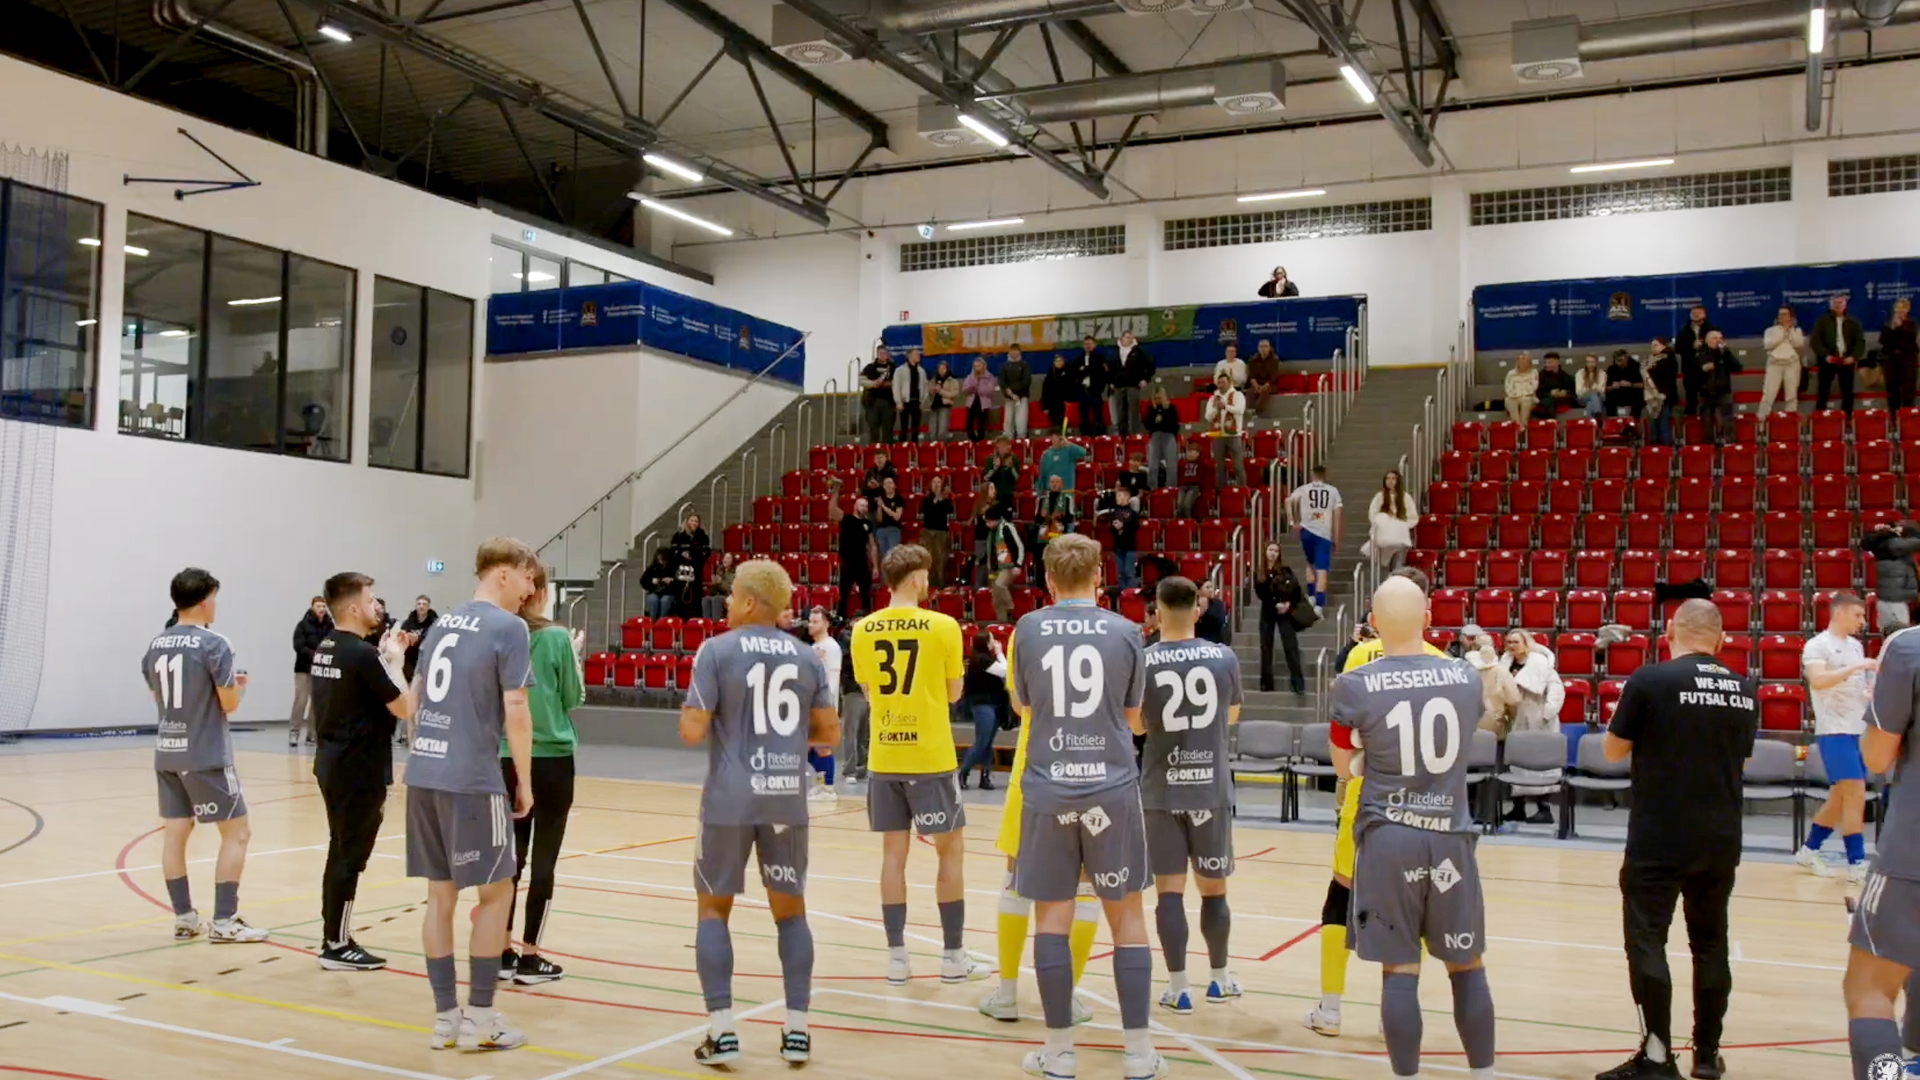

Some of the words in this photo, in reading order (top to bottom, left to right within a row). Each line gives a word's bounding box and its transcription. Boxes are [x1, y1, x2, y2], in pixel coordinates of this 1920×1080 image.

[961, 323, 1033, 348] DUMA
[1042, 314, 1150, 344] KASZUB
[1309, 489, 1330, 509] 90
[437, 613, 481, 633] ROLL
[864, 619, 931, 633] OSTRAK
[1041, 619, 1108, 637] STOLC
[151, 635, 201, 650] FREITAS
[740, 636, 798, 656] MERA
[1145, 646, 1223, 667] ANKOWSKI
[426, 632, 460, 703] 6
[874, 639, 919, 695] 37
[154, 653, 183, 709] 11
[1041, 644, 1105, 718] 19
[1364, 666, 1469, 693] WESSERLING
[1694, 676, 1741, 692] WE-MET
[746, 662, 800, 737] 16
[1154, 665, 1218, 732] 29
[1680, 691, 1728, 706] FUTSAL
[1729, 694, 1754, 711] CLUB
[415, 737, 448, 754] OKTAN
[888, 731, 918, 742] OKTAN
[1066, 733, 1106, 746] fitdieta
[1385, 697, 1460, 777] 10
[1180, 749, 1213, 760] fitdieta
[1065, 762, 1106, 777] OKTAN
[1179, 768, 1214, 780] OKTAN
[1408, 792, 1454, 805] fitdieta
[1403, 811, 1451, 831] OKTAN
